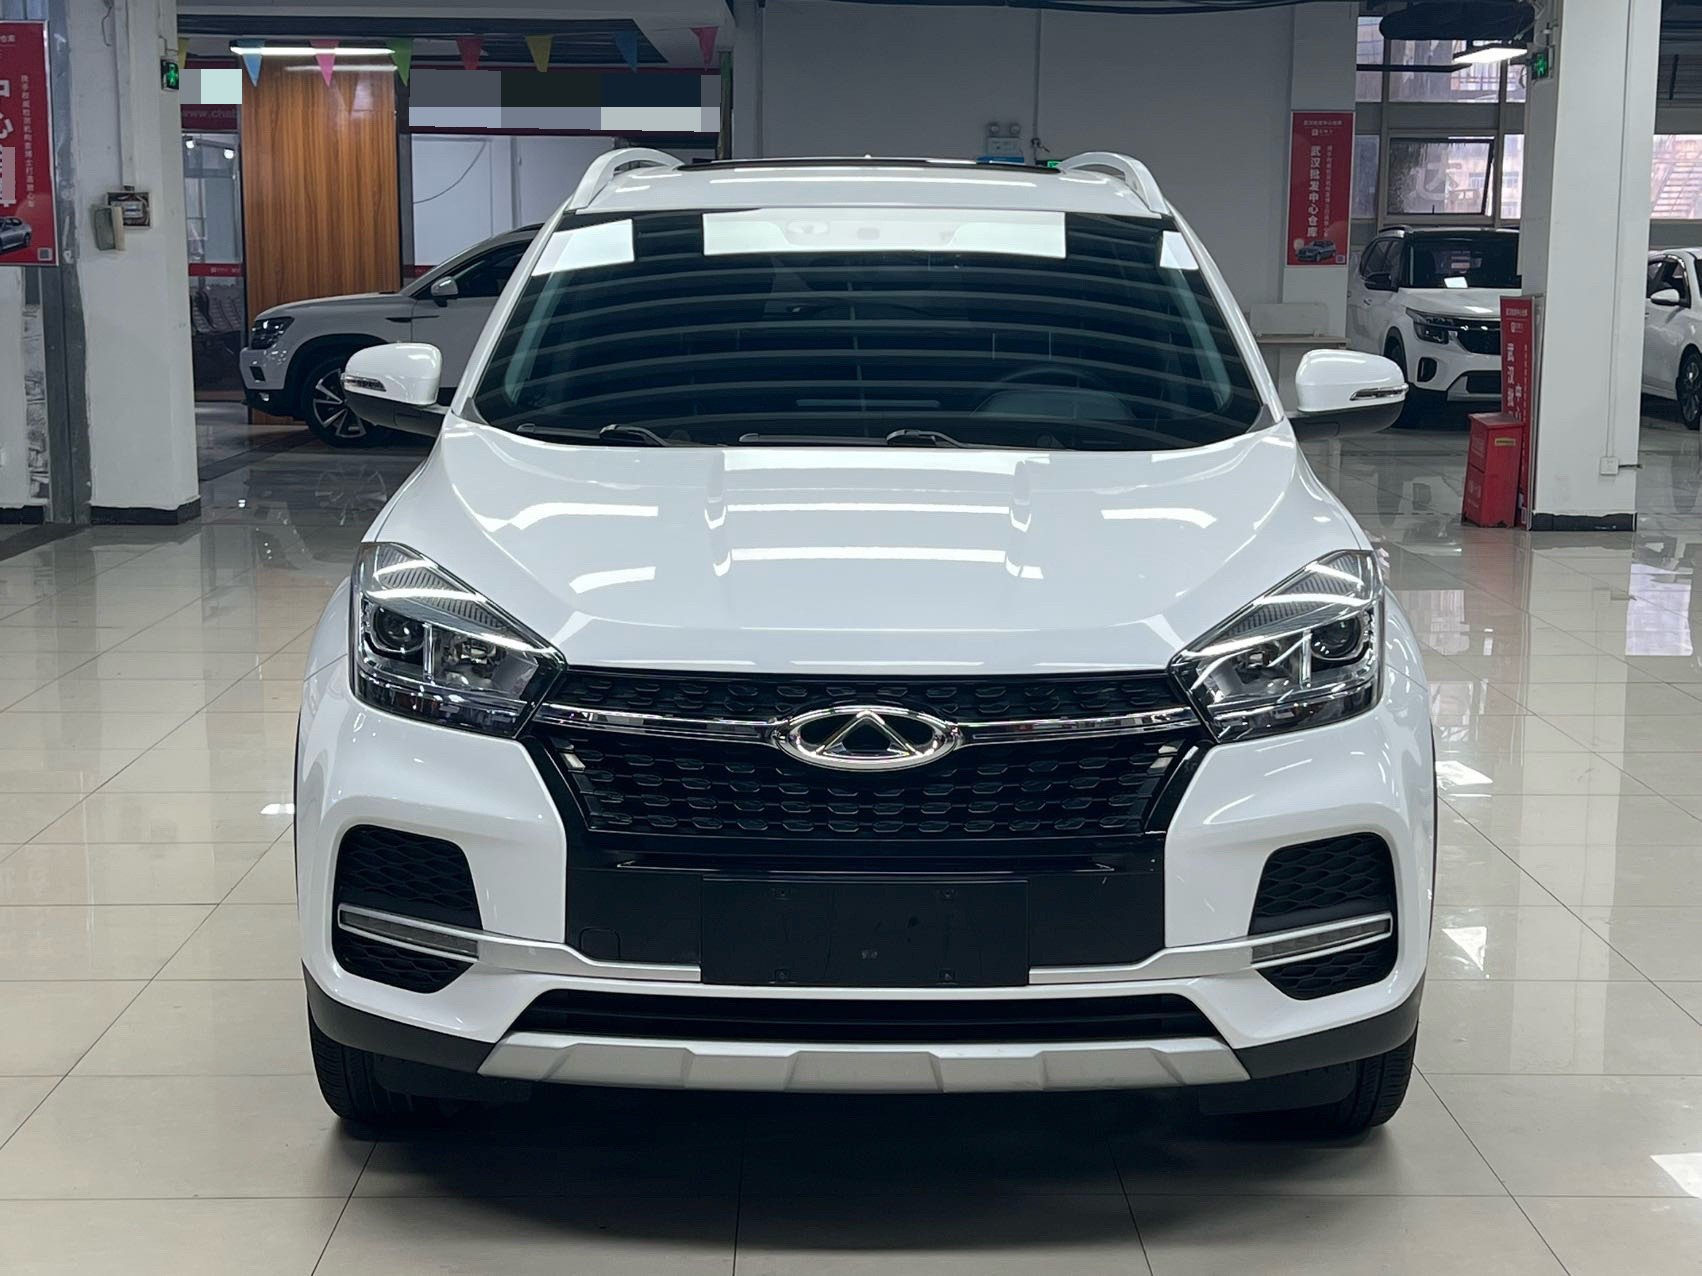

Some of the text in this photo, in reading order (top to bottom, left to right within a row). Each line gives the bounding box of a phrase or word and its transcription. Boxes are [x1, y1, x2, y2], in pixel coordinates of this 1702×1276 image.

[1307, 145, 1321, 238] 武汉批发中心仓库
